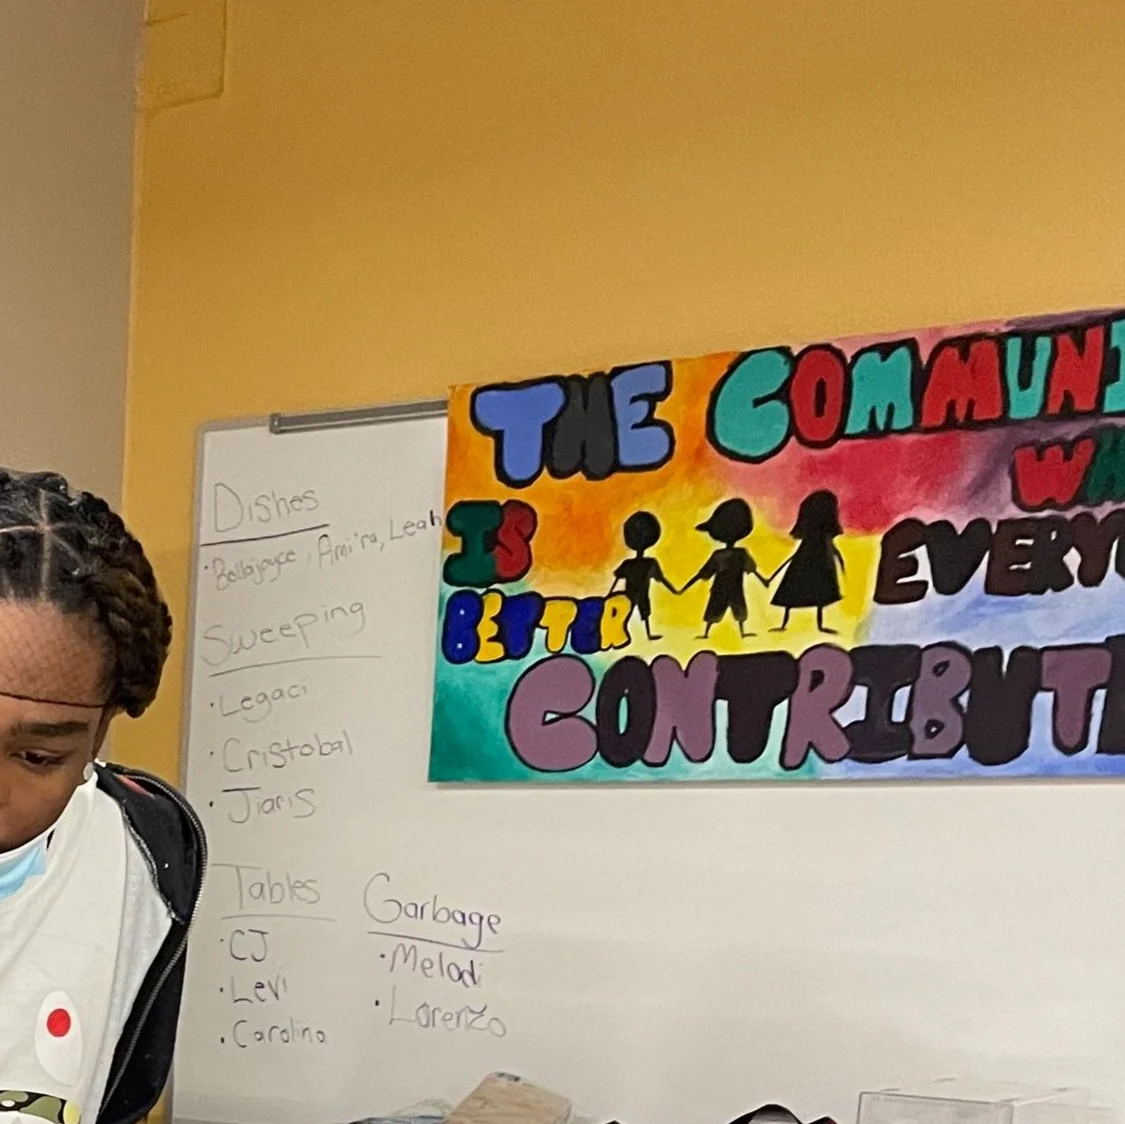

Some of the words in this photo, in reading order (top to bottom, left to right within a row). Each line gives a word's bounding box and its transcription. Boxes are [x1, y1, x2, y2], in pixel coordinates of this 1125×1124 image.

[471, 359, 675, 488] THE
[213, 482, 319, 534] Dishes
[389, 509, 443, 541] Leah
[443, 499, 538, 588] IS
[201, 600, 367, 667] Sweeping
[442, 589, 632, 664] BETTER
[222, 729, 354, 774] Cristobal
[211, 862, 322, 910] Tables
[363, 872, 503, 951] Garbage
[229, 928, 270, 963] CJ
[389, 942, 483, 989] Melodi
[231, 966, 288, 1004] Levi
[389, 984, 508, 1038] Lorenzo
